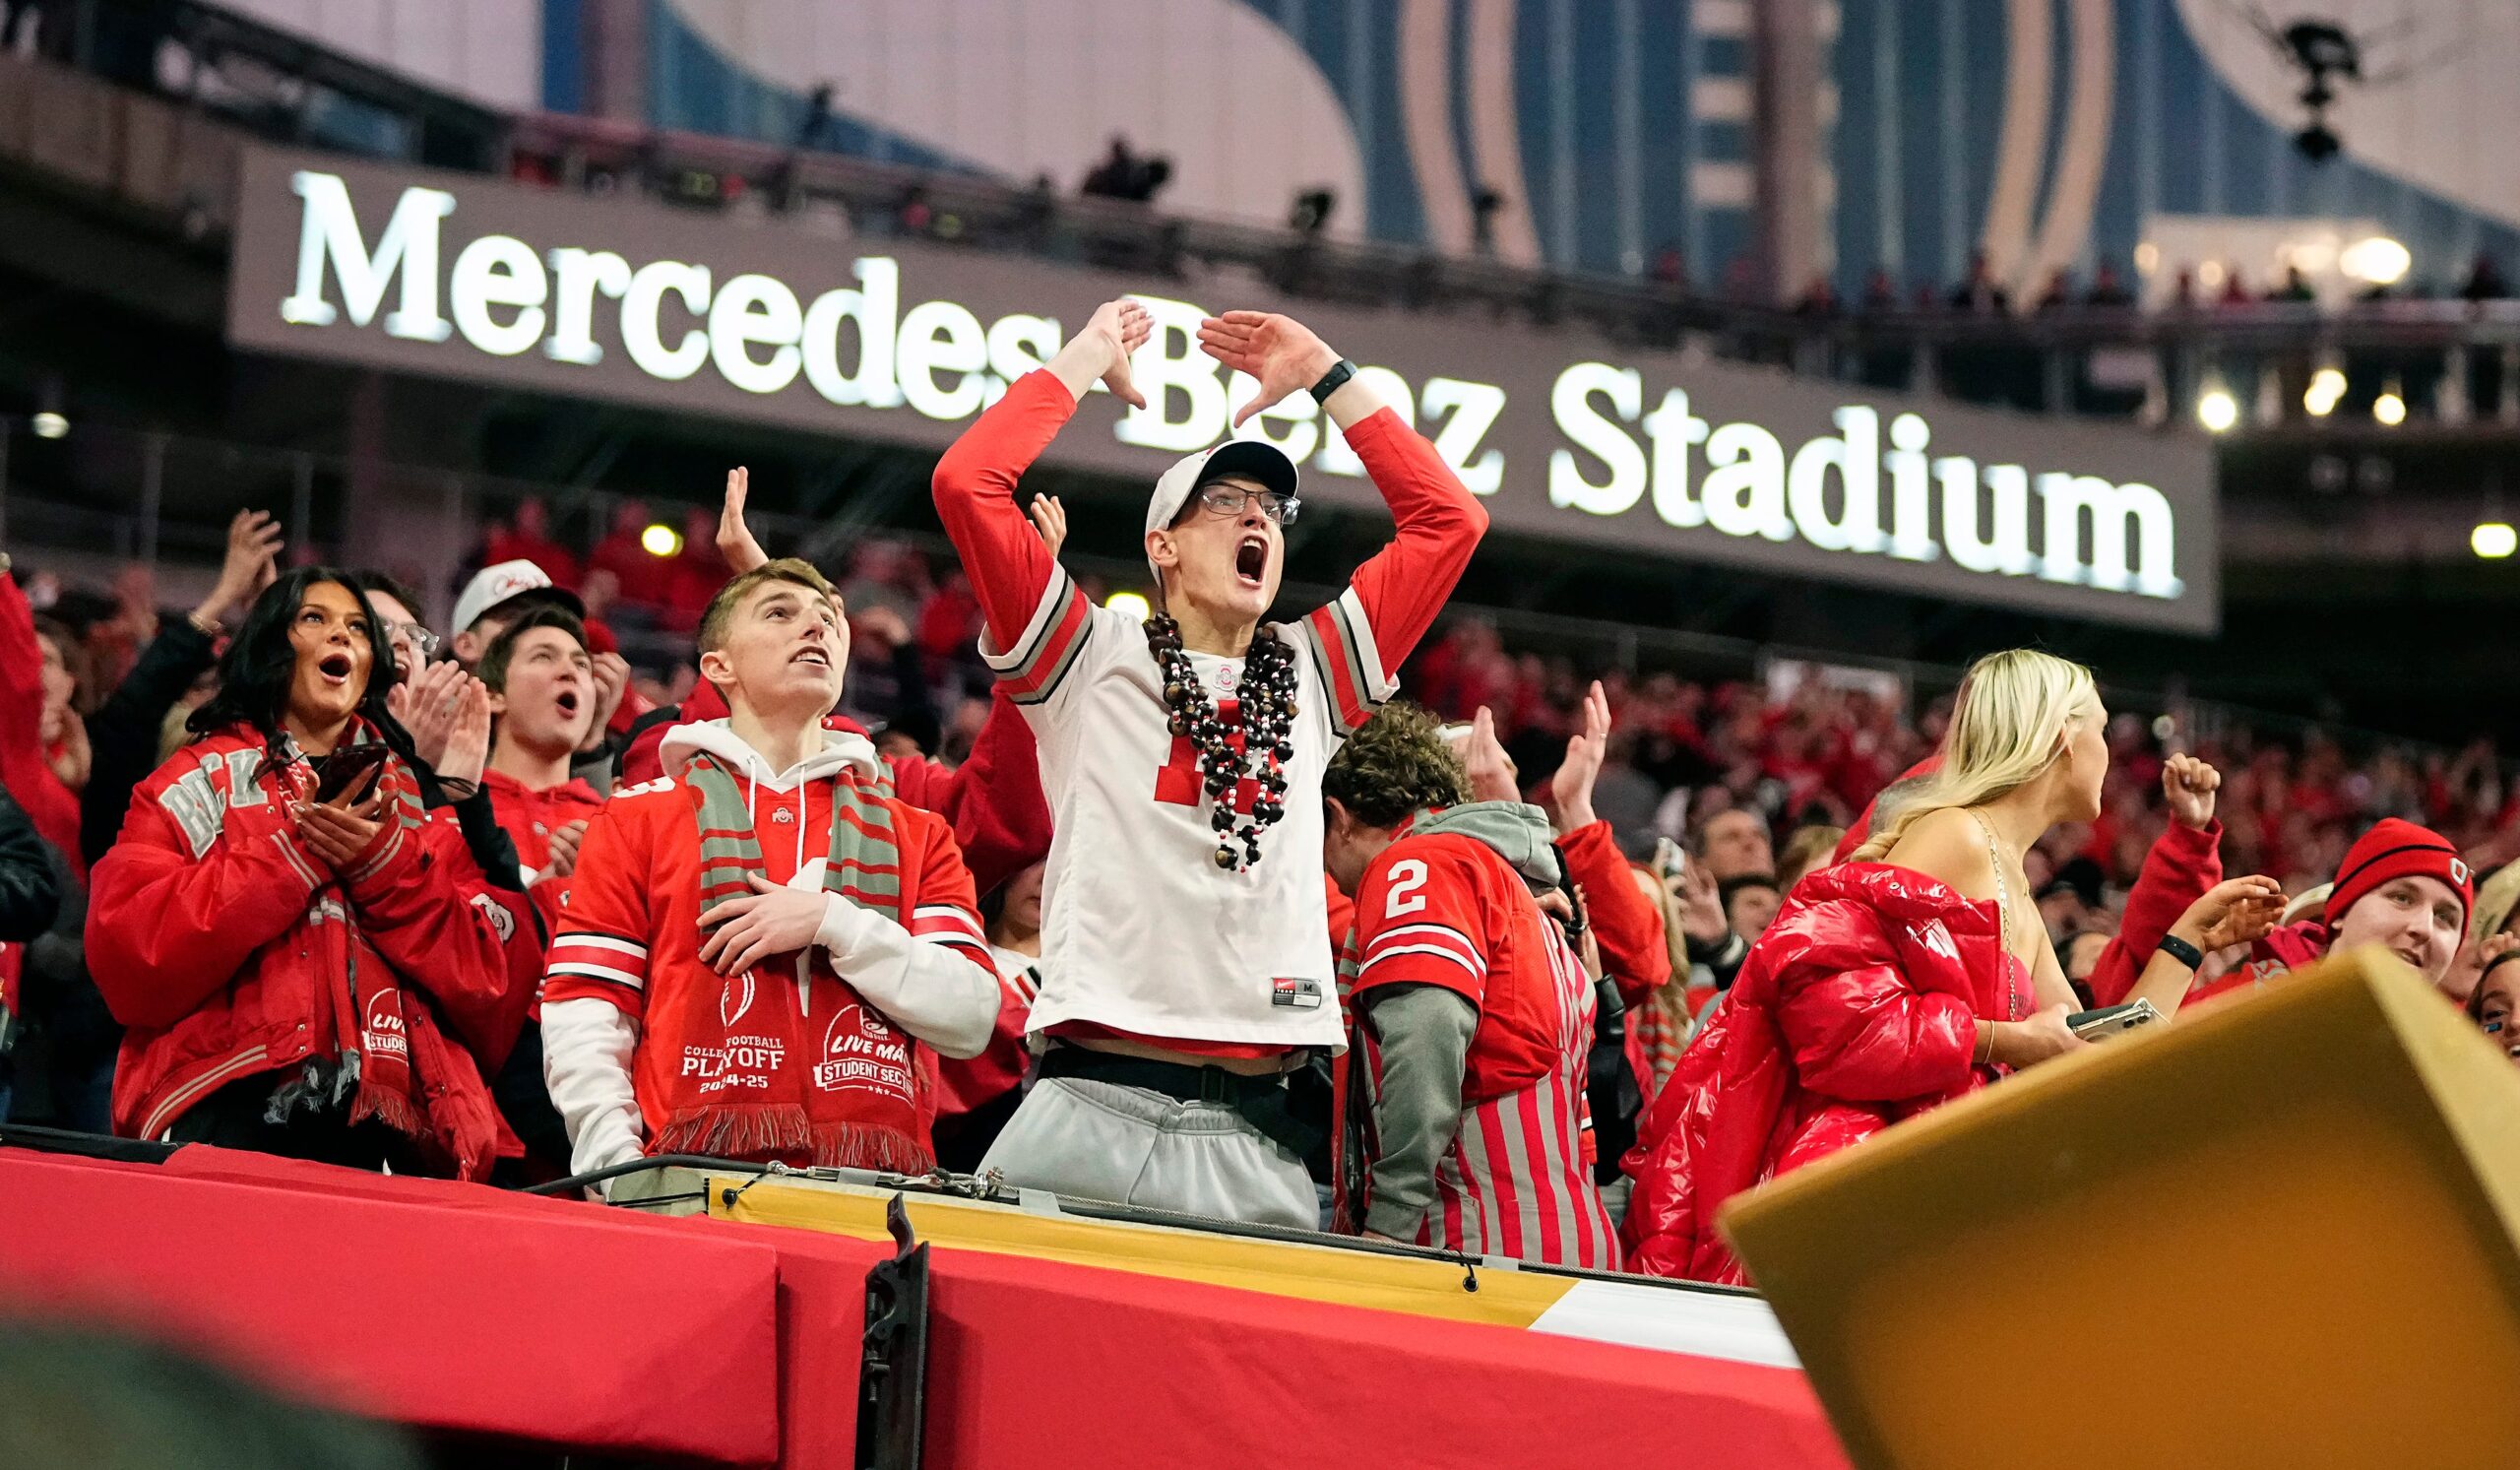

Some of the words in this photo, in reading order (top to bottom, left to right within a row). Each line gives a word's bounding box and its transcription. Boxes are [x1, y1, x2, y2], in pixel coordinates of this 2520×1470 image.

[1549, 361, 2184, 599] Stadium
[1386, 859, 1428, 919] 2
[1303, 984, 1313, 992] M
[370, 1036, 407, 1053] STUDE
[684, 1046, 724, 1058] COLLE
[725, 1036, 784, 1049] FOOTBALL
[830, 1035, 873, 1054] LIVE
[876, 1044, 907, 1065] MÁ
[824, 1060, 879, 1081] STUDENT
